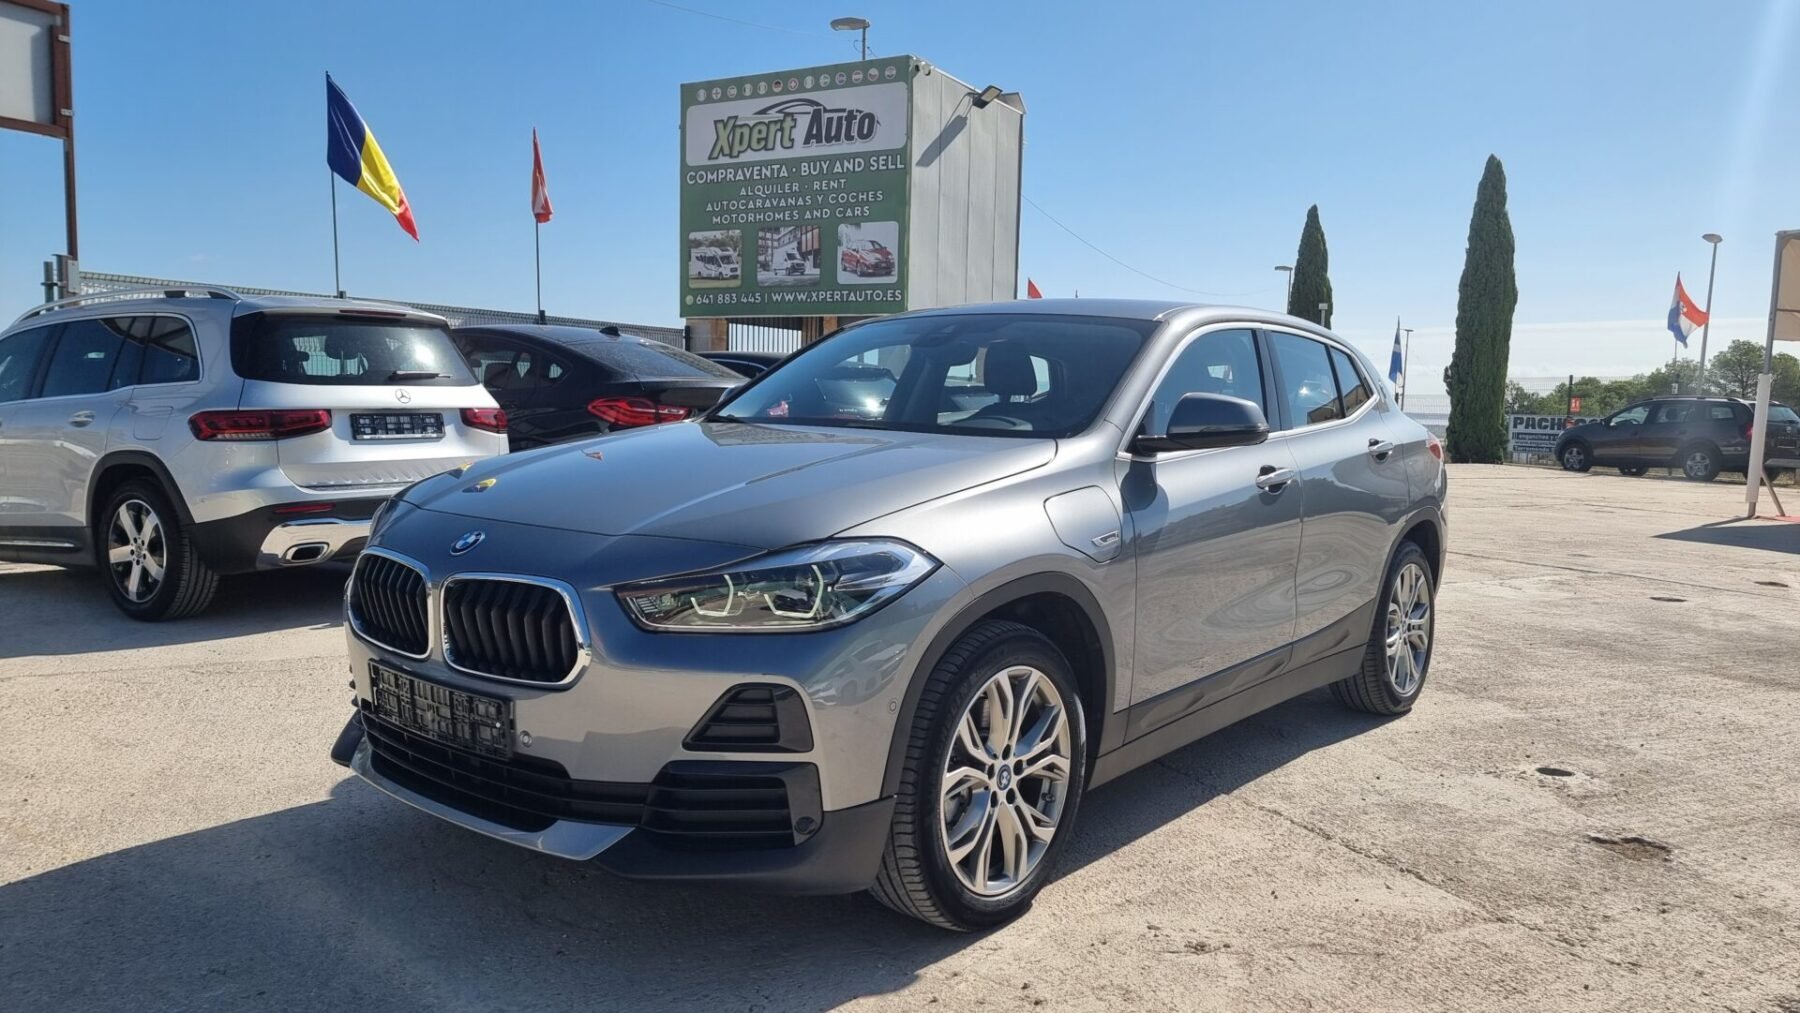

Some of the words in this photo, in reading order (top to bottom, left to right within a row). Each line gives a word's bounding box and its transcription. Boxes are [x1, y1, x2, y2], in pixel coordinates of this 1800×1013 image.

[708, 113, 798, 160] Xpert
[803, 108, 877, 147] Auto
[686, 164, 789, 185] COMPRAVENTA
[800, 160, 830, 176] BUY
[832, 157, 865, 174] AND
[869, 154, 905, 171] SELL
[739, 182, 800, 197] ALQUILER
[813, 179, 847, 191] RENT
[705, 195, 812, 212] AUTOCARAVANAS
[816, 194, 824, 205] Y
[828, 190, 884, 204] COCHES
[712, 210, 799, 225] MOTORHOMES
[804, 208, 831, 219] AND
[835, 205, 870, 218] CARS
[695, 294, 714, 305] 641
[717, 293, 737, 305] 883
[740, 292, 762, 304] 445
[771, 289, 902, 303] WWW.XPERTAUTO.ES
